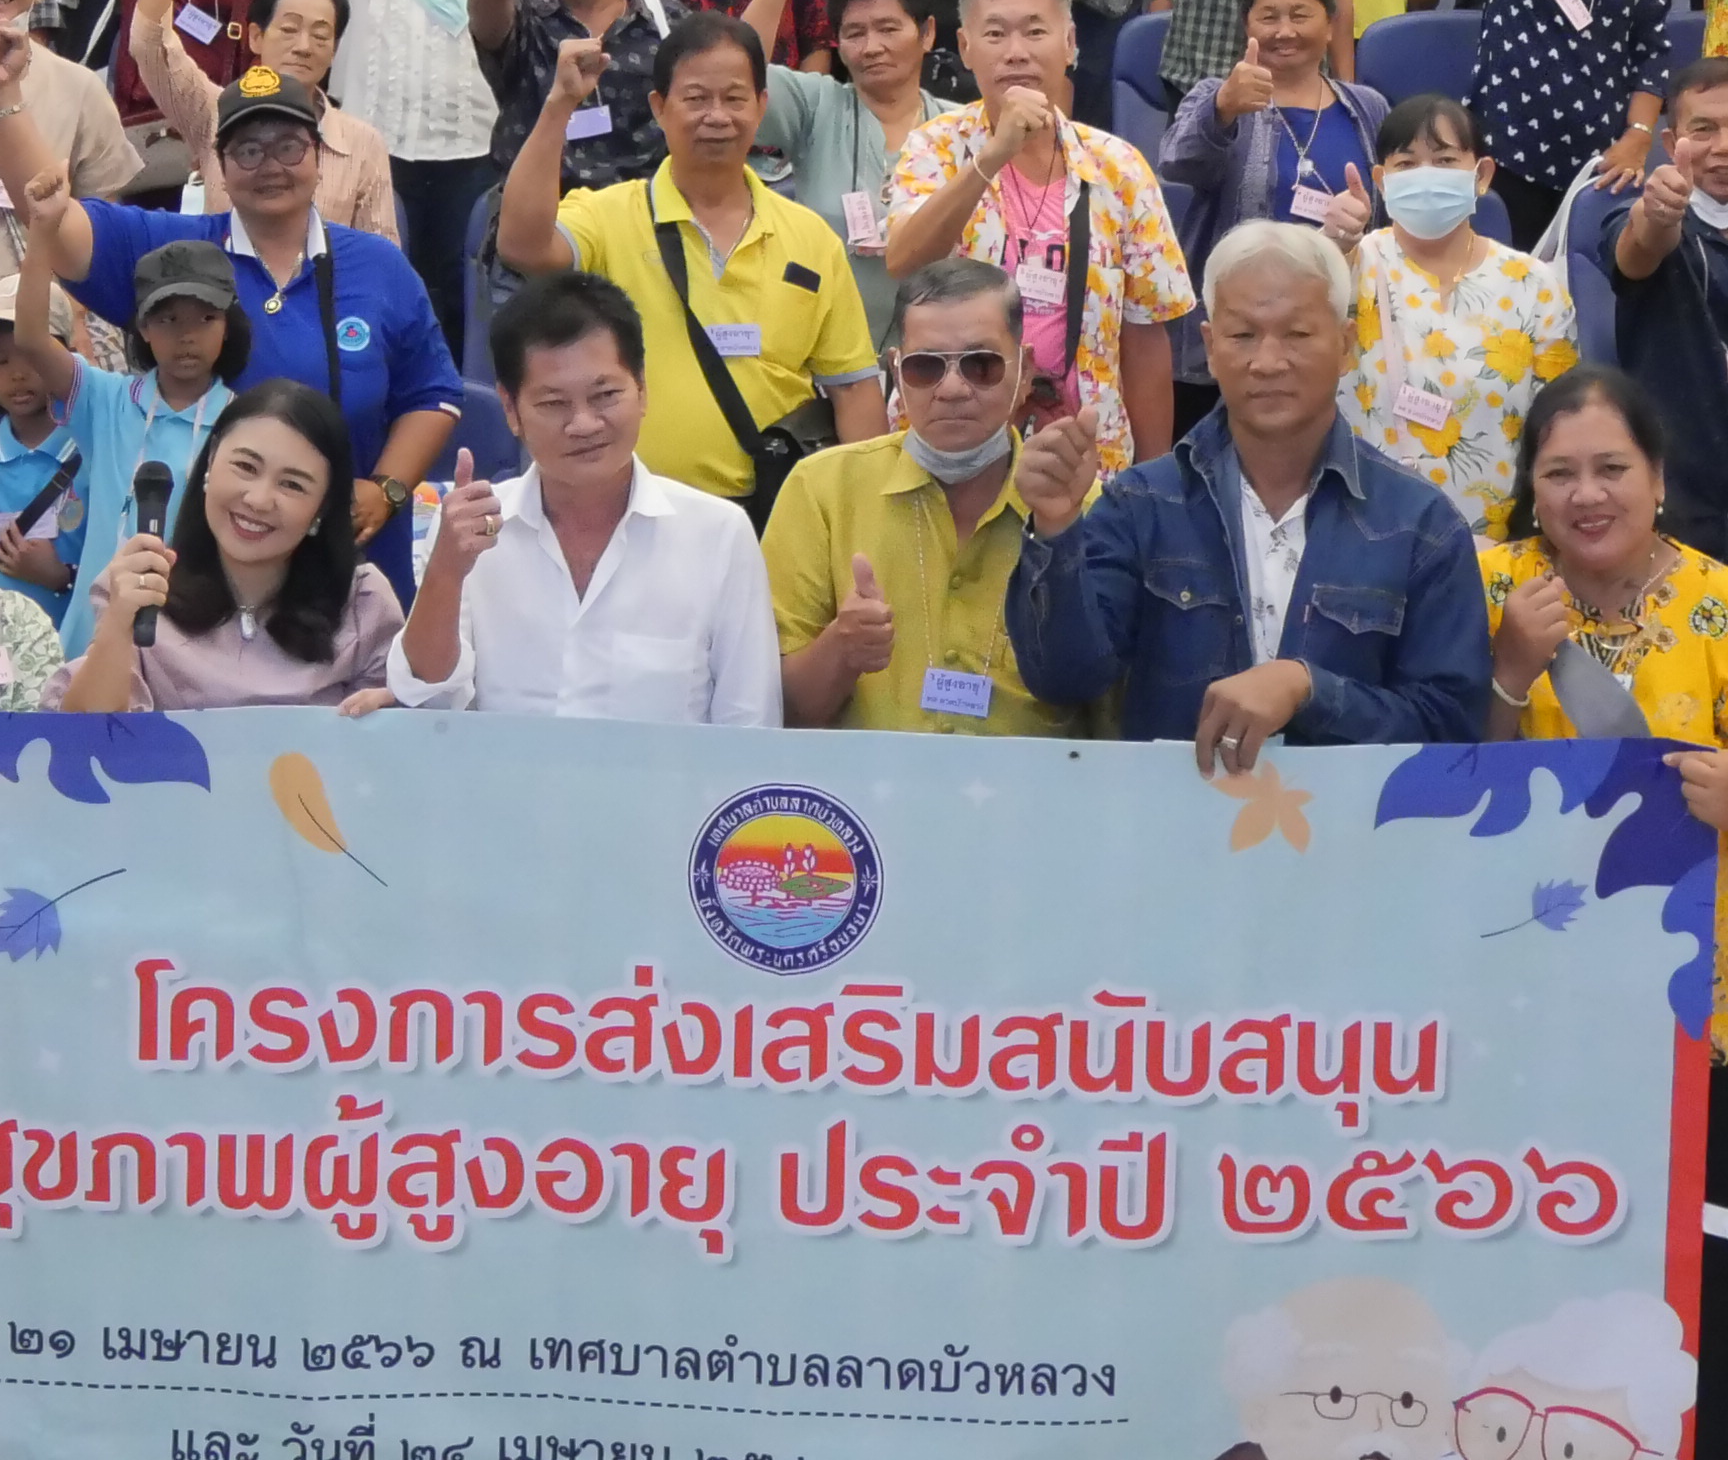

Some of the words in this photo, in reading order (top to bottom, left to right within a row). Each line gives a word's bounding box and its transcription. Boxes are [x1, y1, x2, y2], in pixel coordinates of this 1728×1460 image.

[136, 959, 1437, 1128] โครงการส่งเสริมสนับสนุน
[780, 1120, 1166, 1241] ประจำปี
[1219, 1147, 1618, 1236] ๒๕๖๖
[7, 1321, 76, 1359] ๒๑
[103, 1326, 277, 1369] เมษายน
[301, 1334, 435, 1372] ๒๕๖๖
[459, 1336, 501, 1369] ณ
[528, 1334, 1116, 1397] เทศบาลตำบลลาดบัวหลวง
[171, 1429, 260, 1460] และ
[281, 1412, 375, 1460] วันที่
